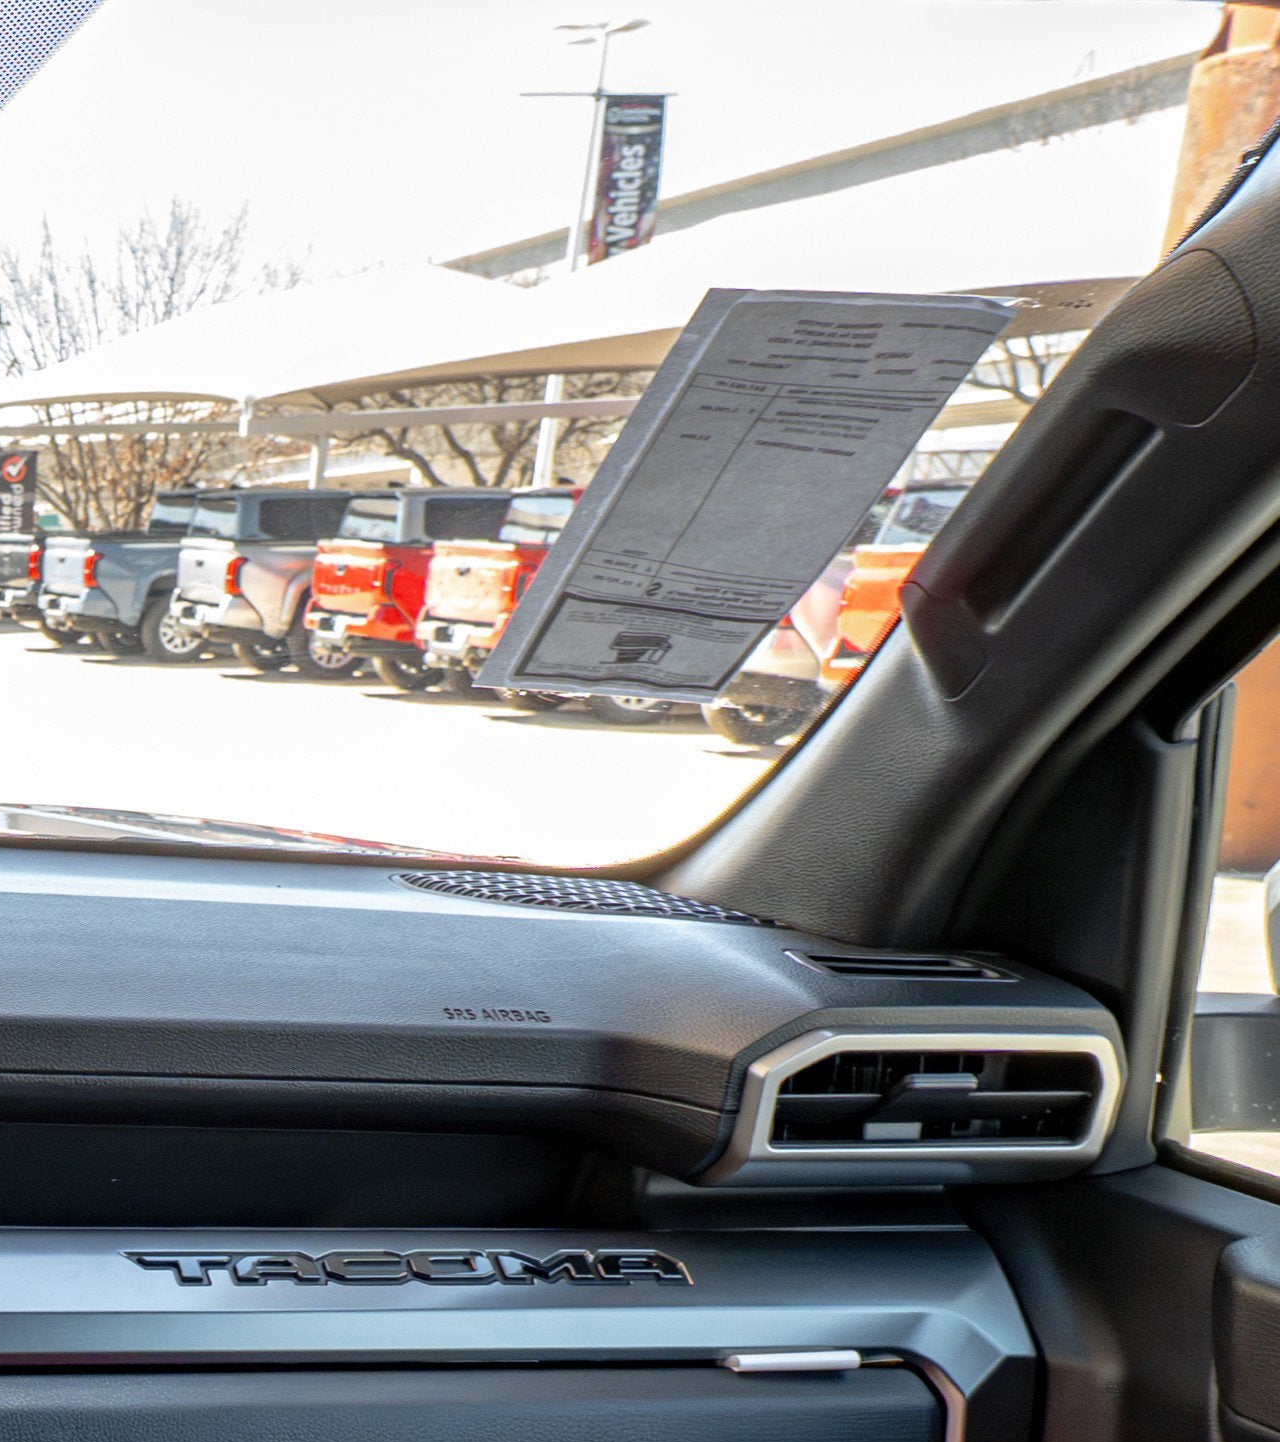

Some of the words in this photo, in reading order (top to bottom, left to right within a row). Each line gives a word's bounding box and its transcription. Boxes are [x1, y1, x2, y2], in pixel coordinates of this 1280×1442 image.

[604, 143, 647, 244] Vehicles
[442, 1007, 477, 1020] SRS
[481, 1008, 552, 1023] AIRBAG
[116, 1249, 695, 1287] TACOMA
